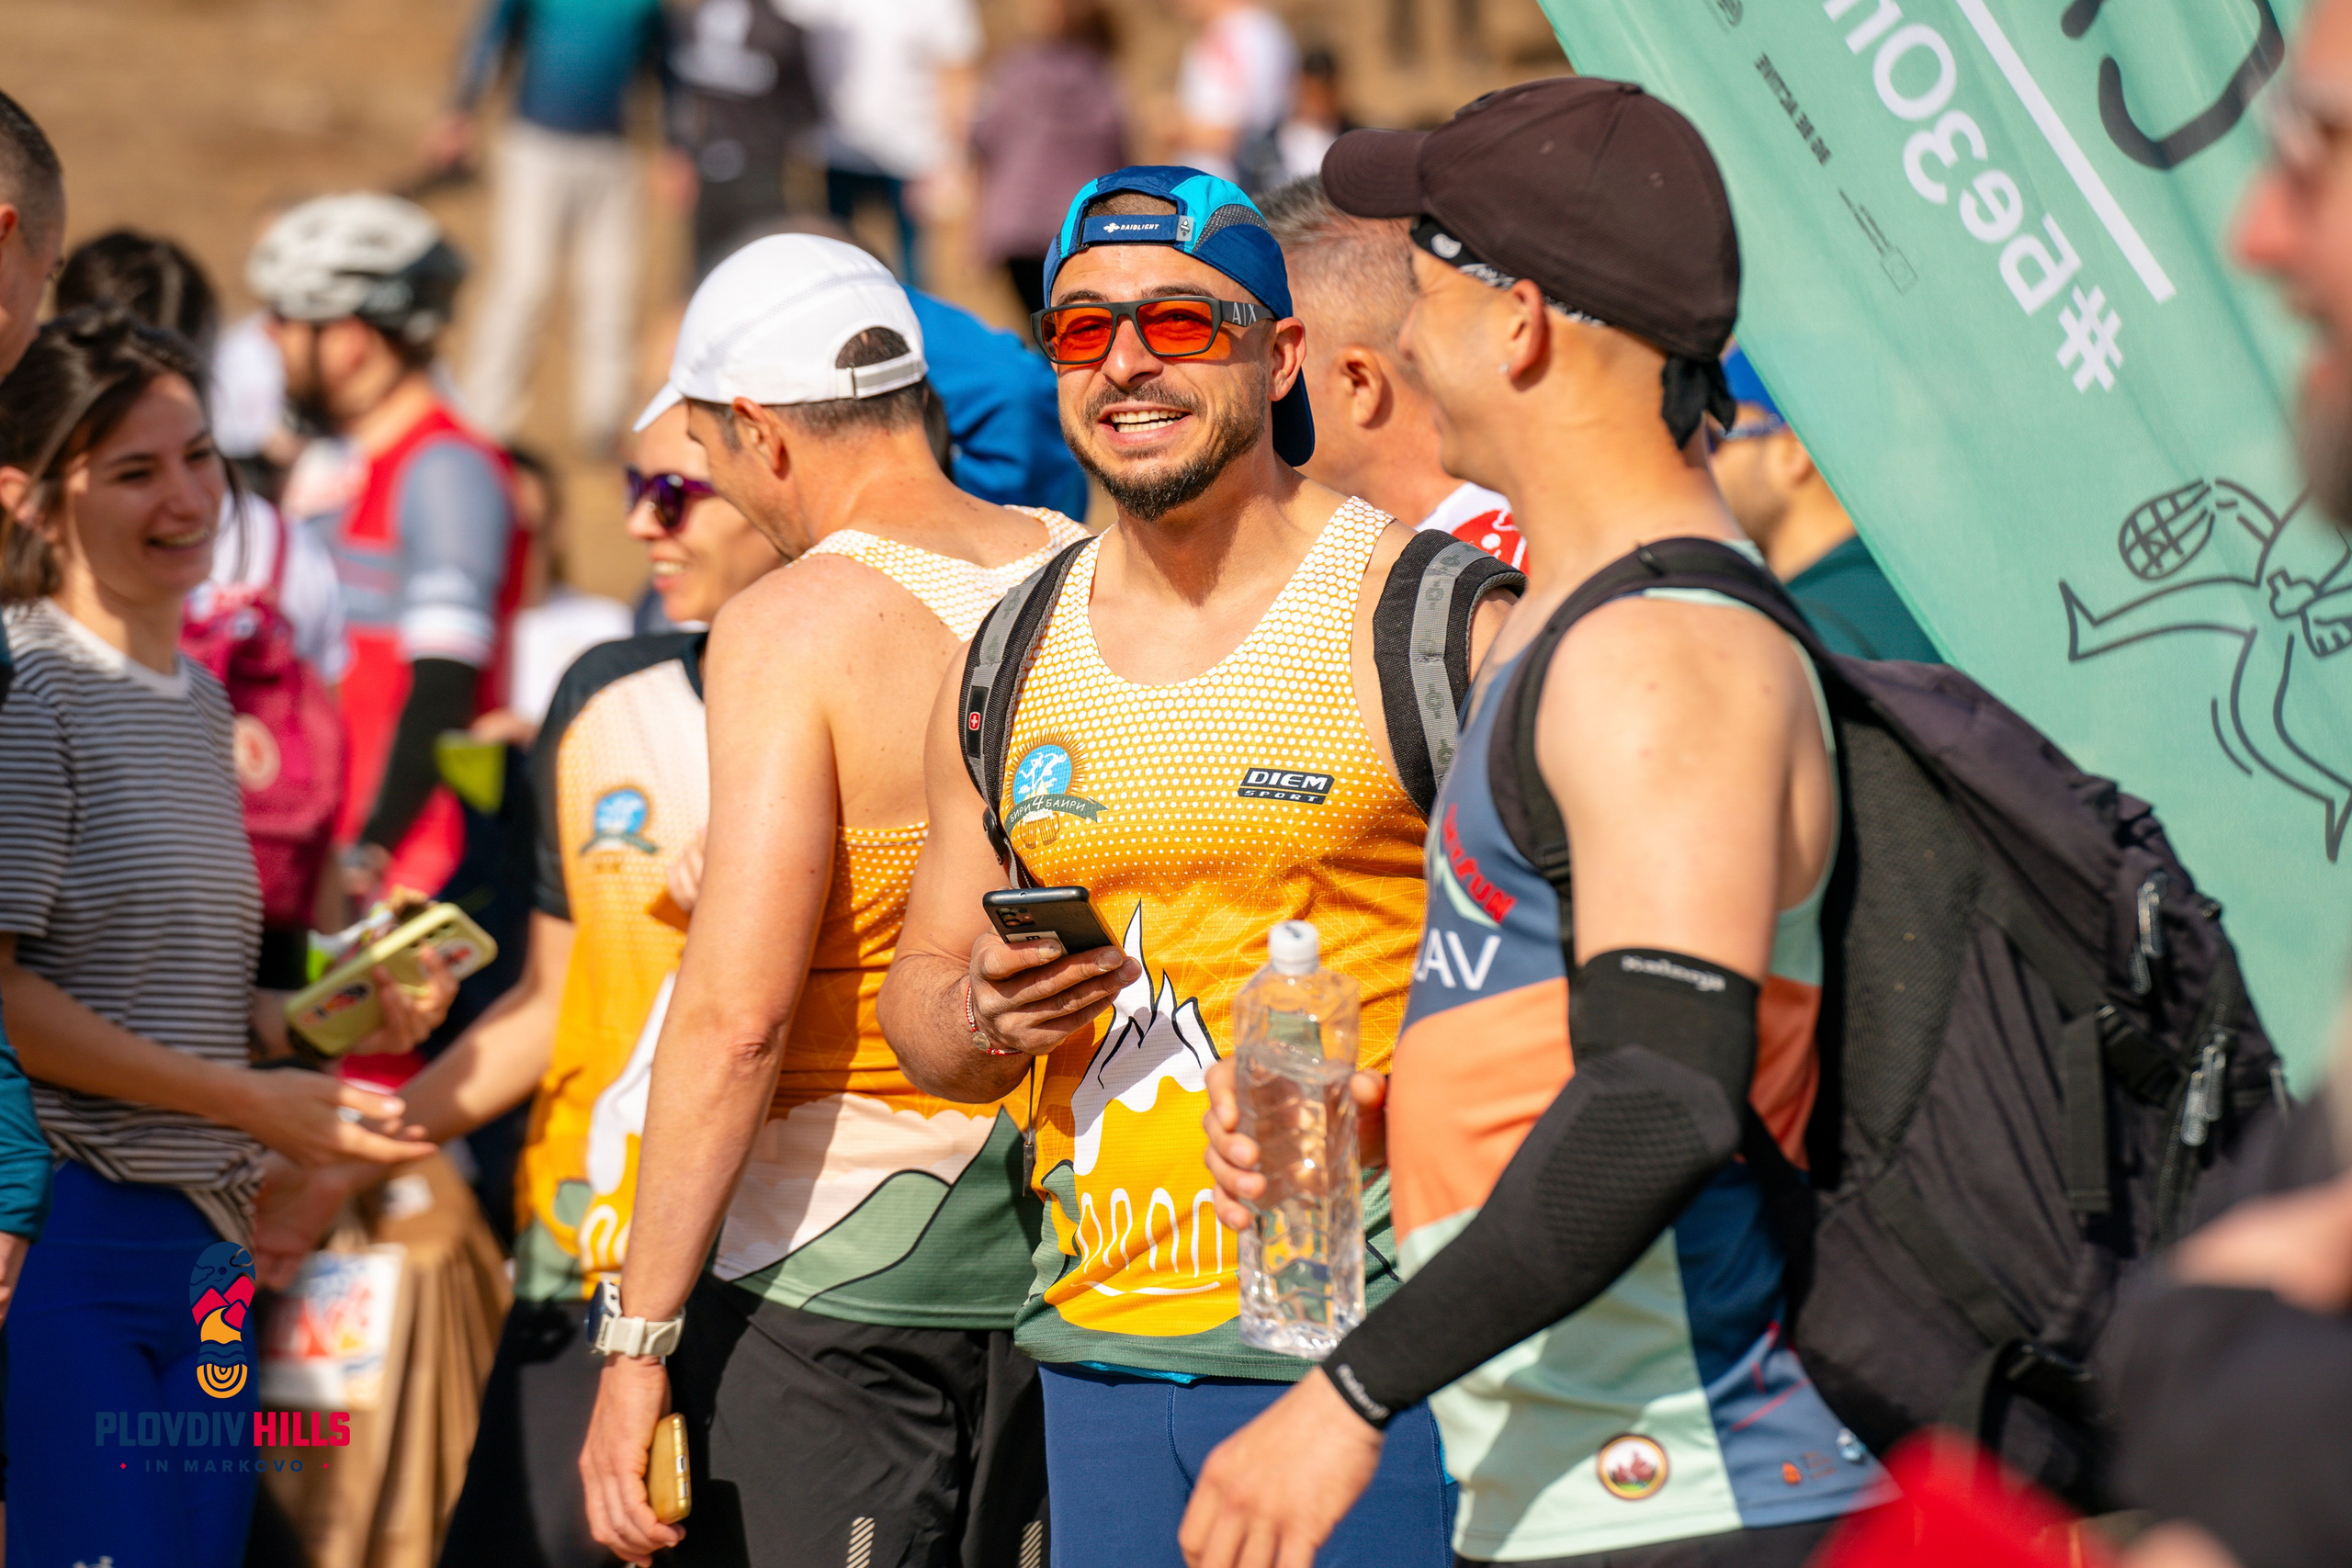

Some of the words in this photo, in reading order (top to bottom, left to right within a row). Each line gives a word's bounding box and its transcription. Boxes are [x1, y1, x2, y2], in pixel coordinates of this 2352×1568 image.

[1246, 770, 1329, 791] DIEM
[1243, 789, 1318, 802] SPORT
[1010, 804, 1031, 823] БИРИ
[1032, 794, 1045, 809] 4
[1414, 927, 1502, 991] AV
